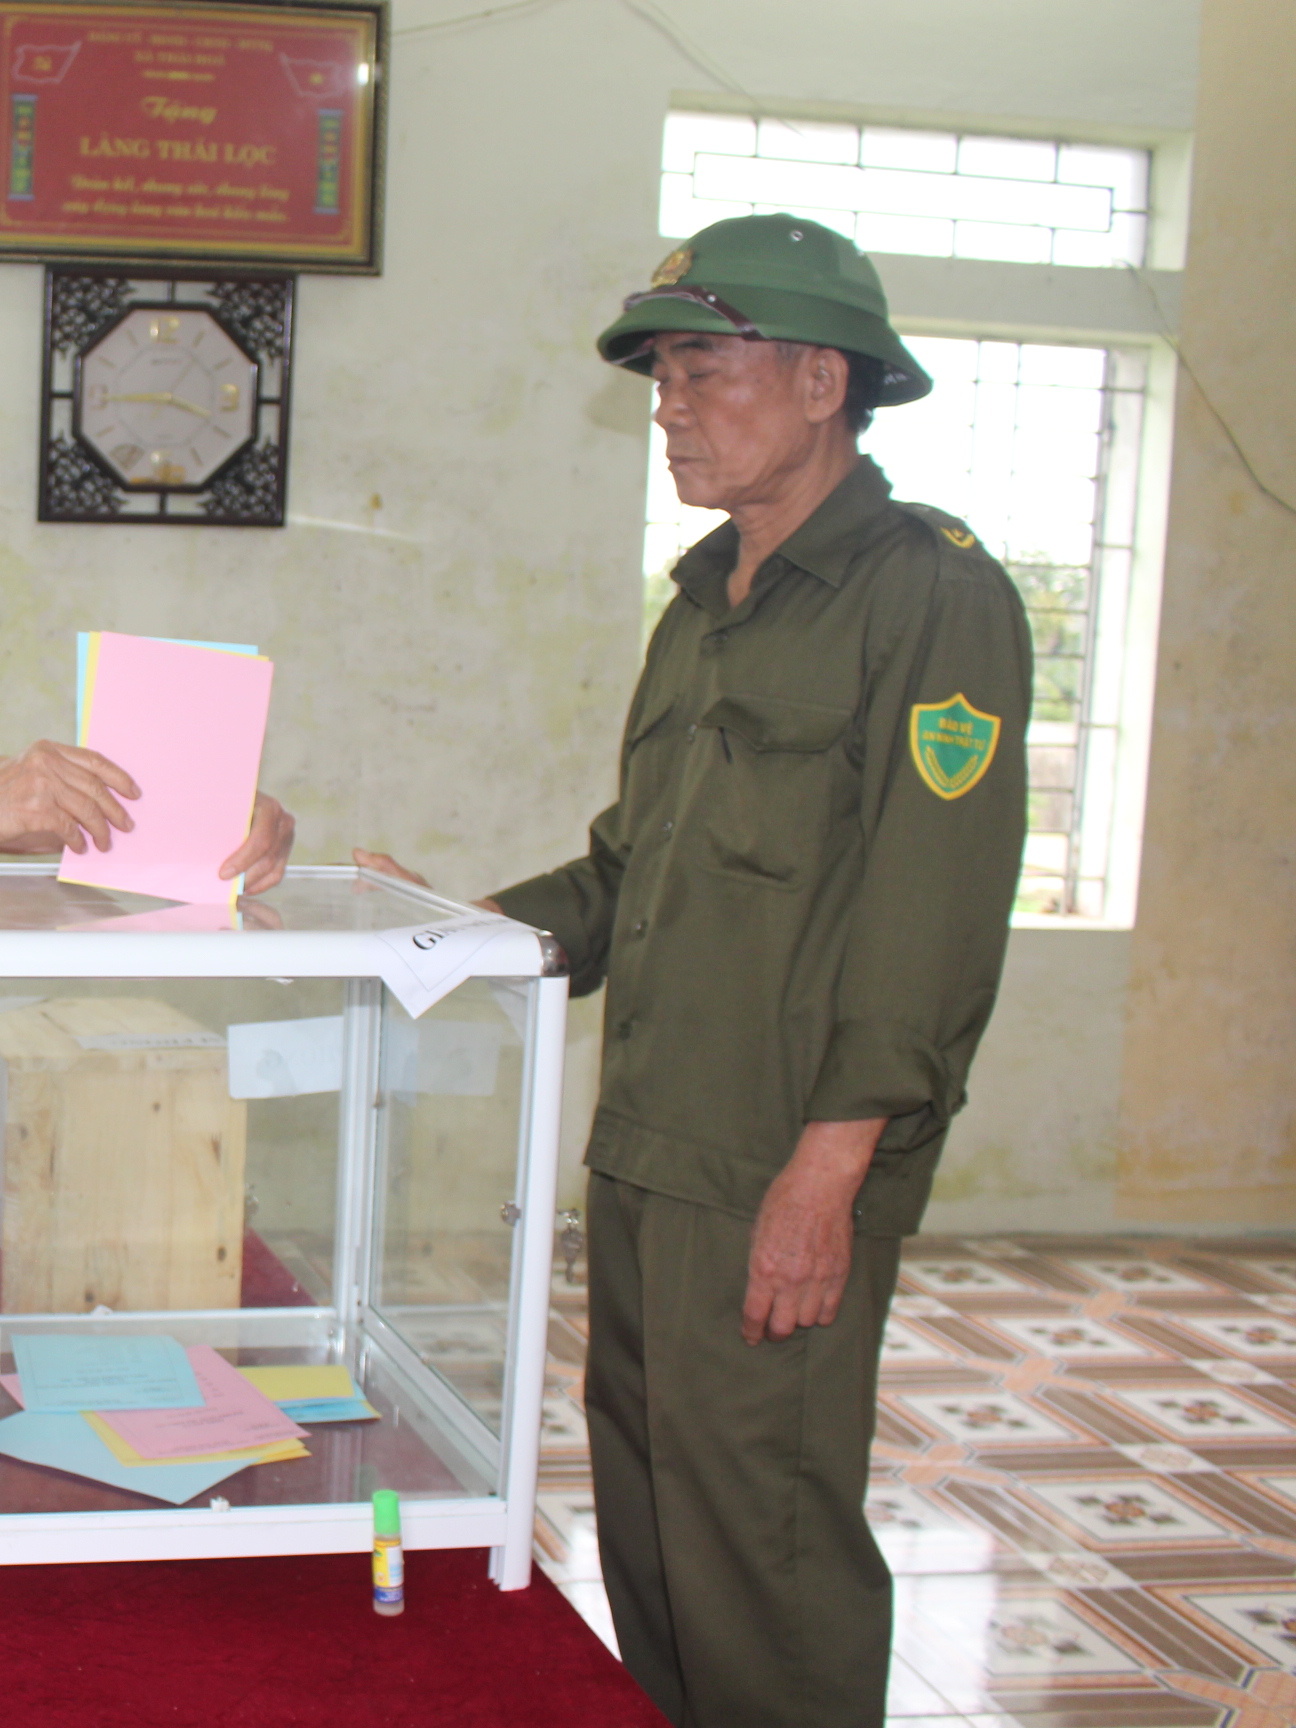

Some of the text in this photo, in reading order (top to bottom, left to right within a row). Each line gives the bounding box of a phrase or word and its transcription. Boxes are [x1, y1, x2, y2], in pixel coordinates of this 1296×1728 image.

[80, 131, 151, 159] LÀNG
[156, 136, 218, 162] THÁI
[149, 316, 181, 344] 12
[220, 383, 240, 412] 3
